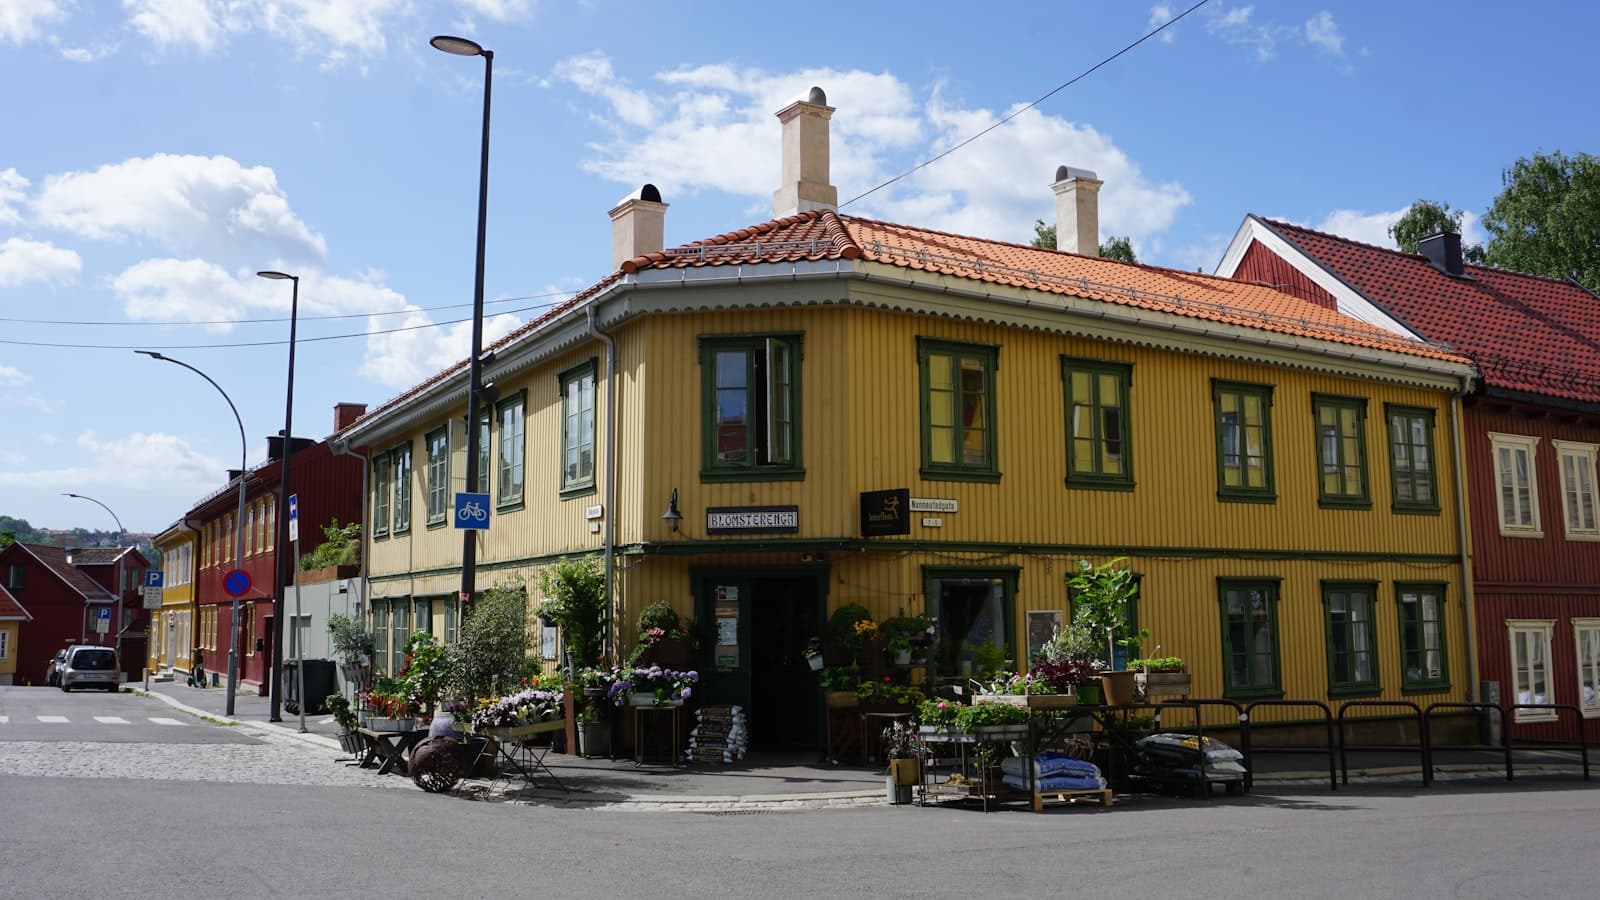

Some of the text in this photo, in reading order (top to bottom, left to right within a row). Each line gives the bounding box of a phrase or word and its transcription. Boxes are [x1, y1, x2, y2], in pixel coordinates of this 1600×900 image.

[911, 499, 955, 511] Nannestadgata
[149, 572, 160, 585] P
[100, 609, 109, 618] P
